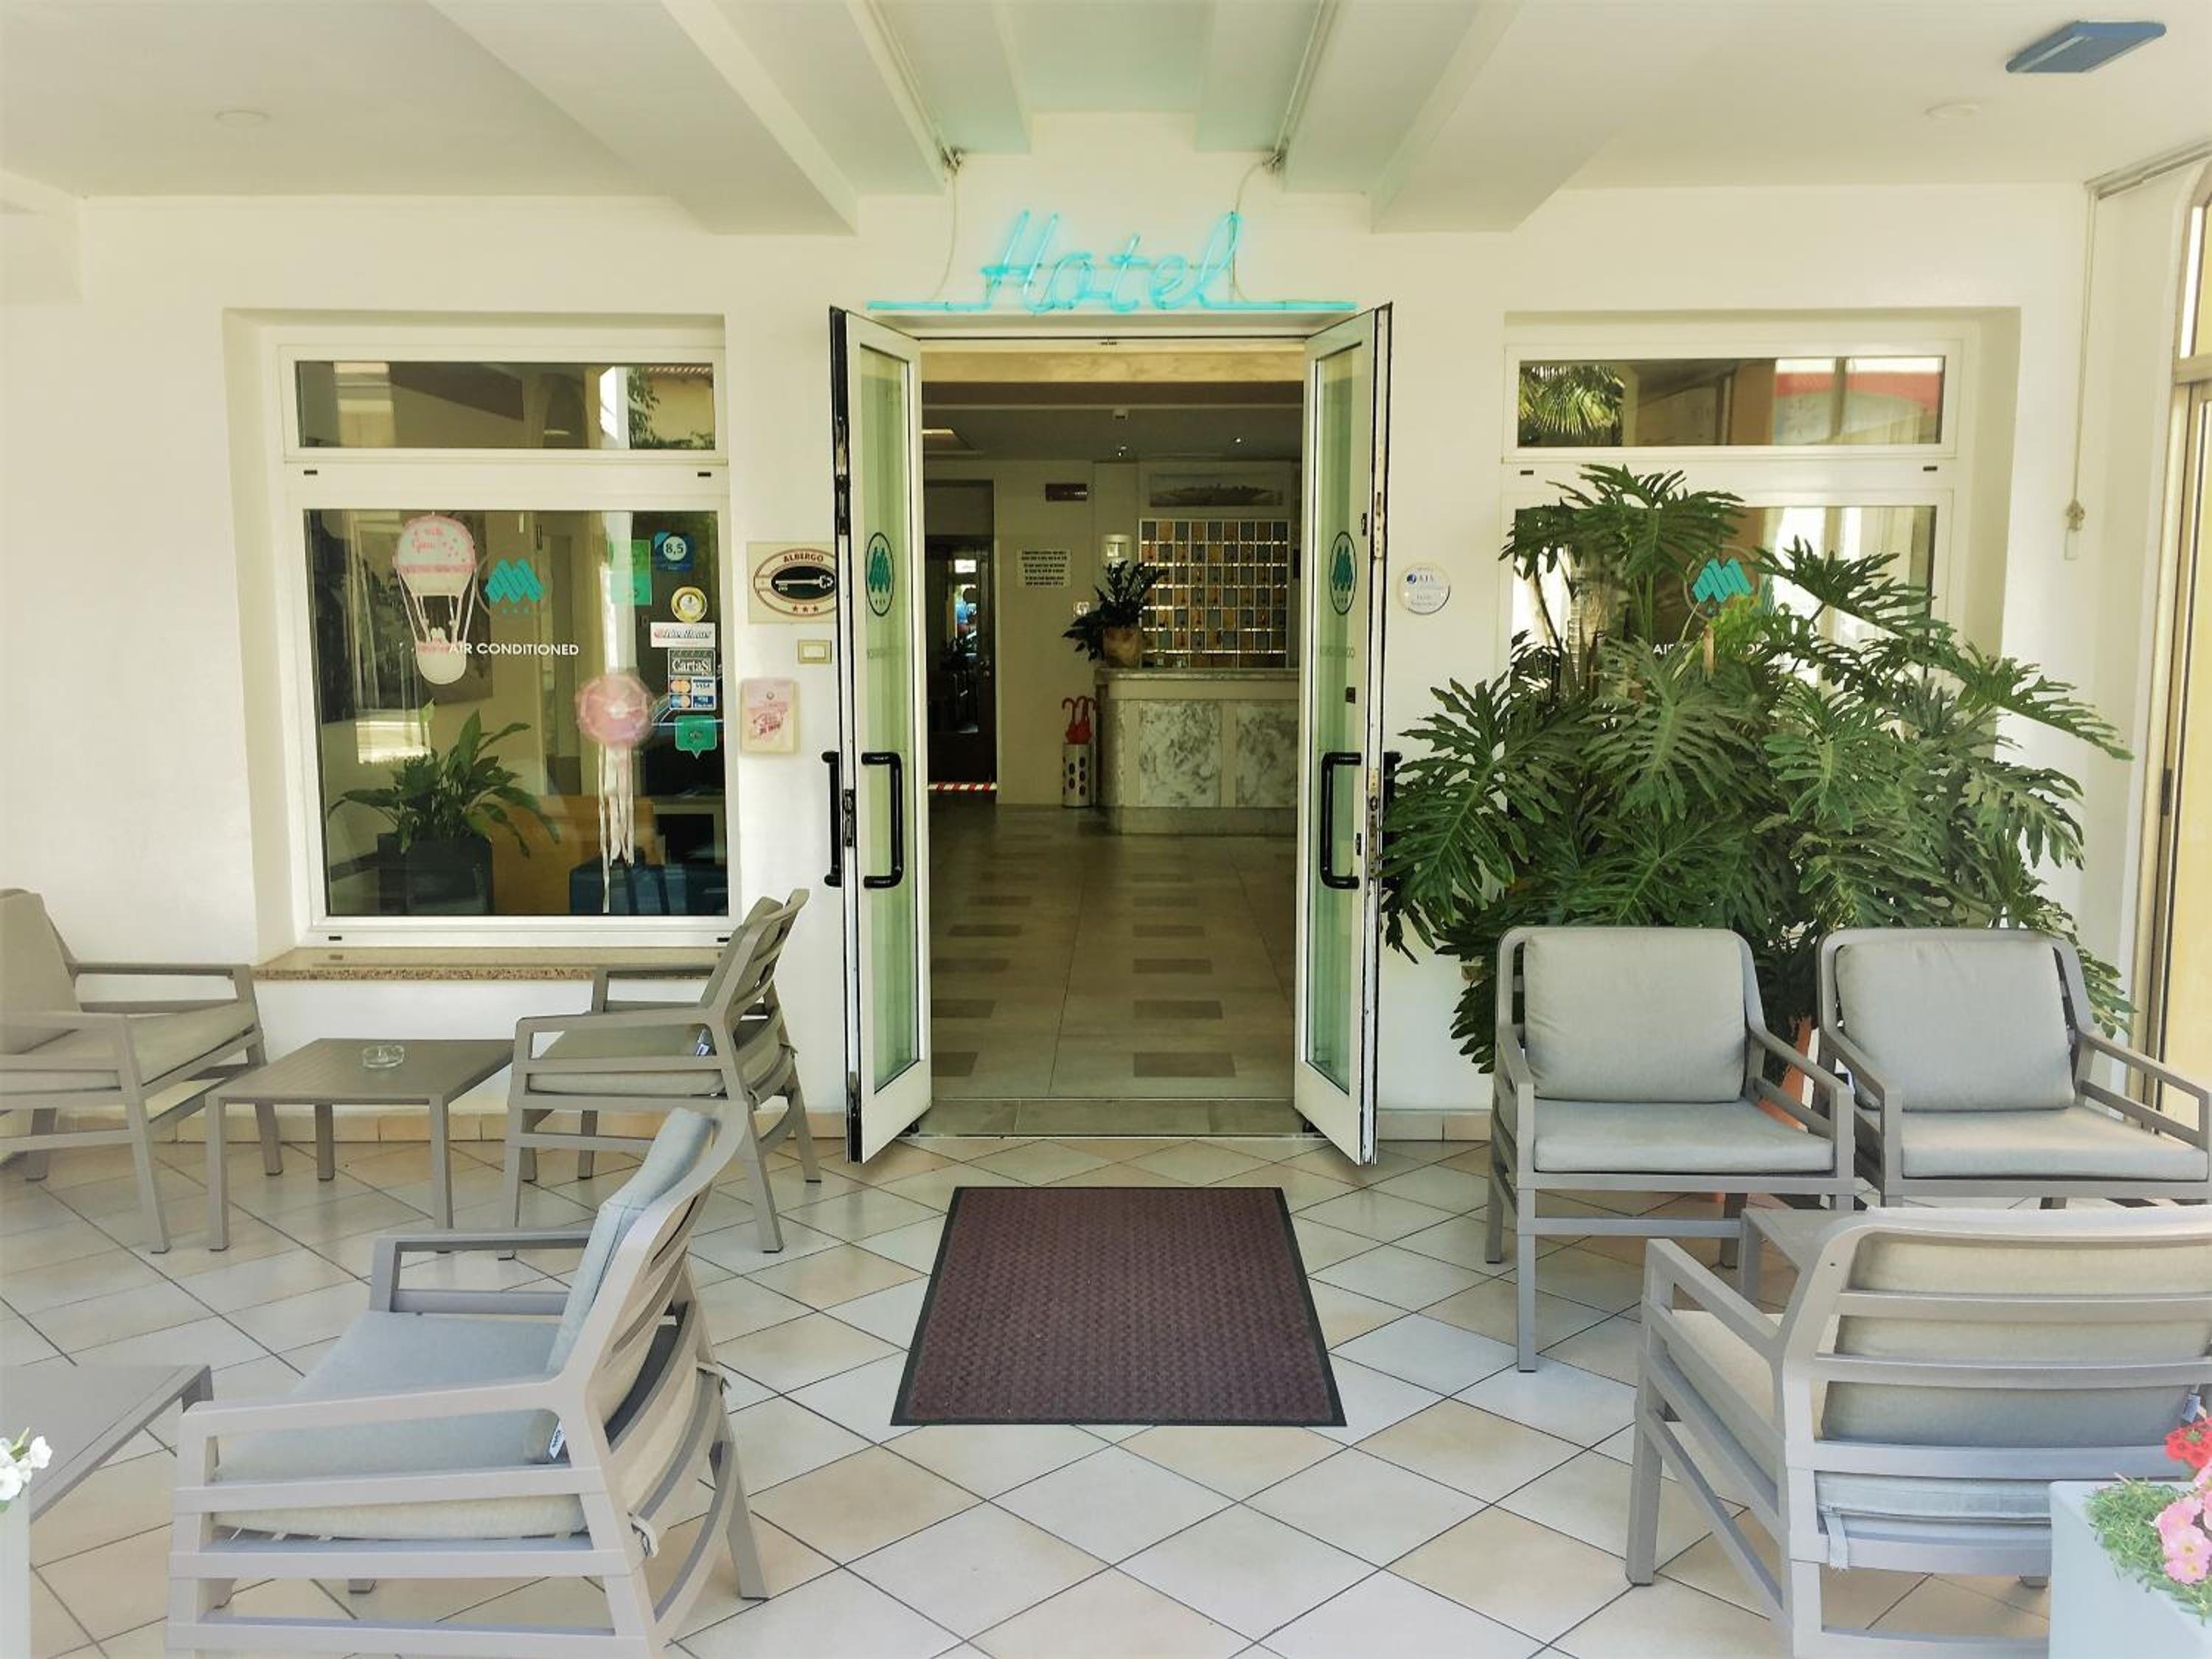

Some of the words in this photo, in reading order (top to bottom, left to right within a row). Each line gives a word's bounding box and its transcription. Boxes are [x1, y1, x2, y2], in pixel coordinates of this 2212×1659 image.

[979, 209, 1243, 314] Hotel
[665, 543, 684, 555] 8,5
[784, 552, 824, 563] ALBERGO
[449, 642, 473, 655] AIR
[476, 642, 579, 655] CONDITIONED
